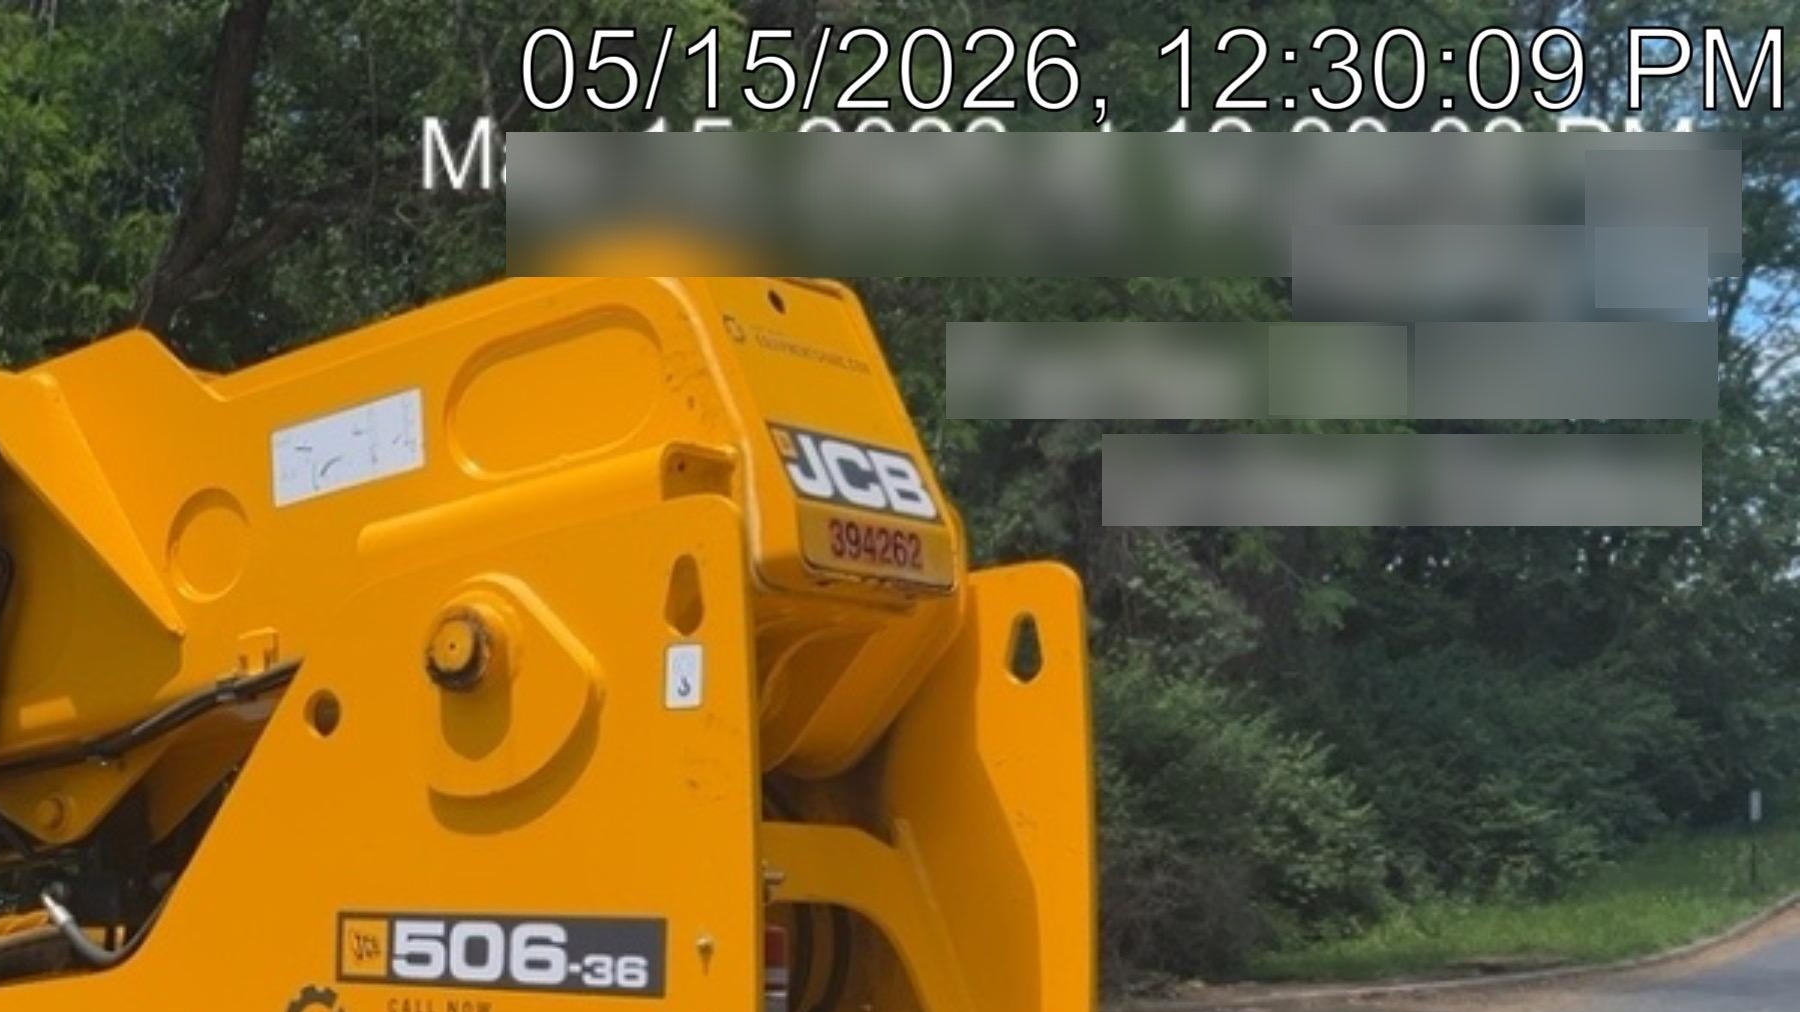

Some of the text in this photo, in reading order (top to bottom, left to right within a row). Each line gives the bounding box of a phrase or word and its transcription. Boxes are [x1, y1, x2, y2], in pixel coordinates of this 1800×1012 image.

[785, 433, 938, 520] JCB
[830, 518, 923, 569] 394262
[391, 919, 649, 989] 506-36
